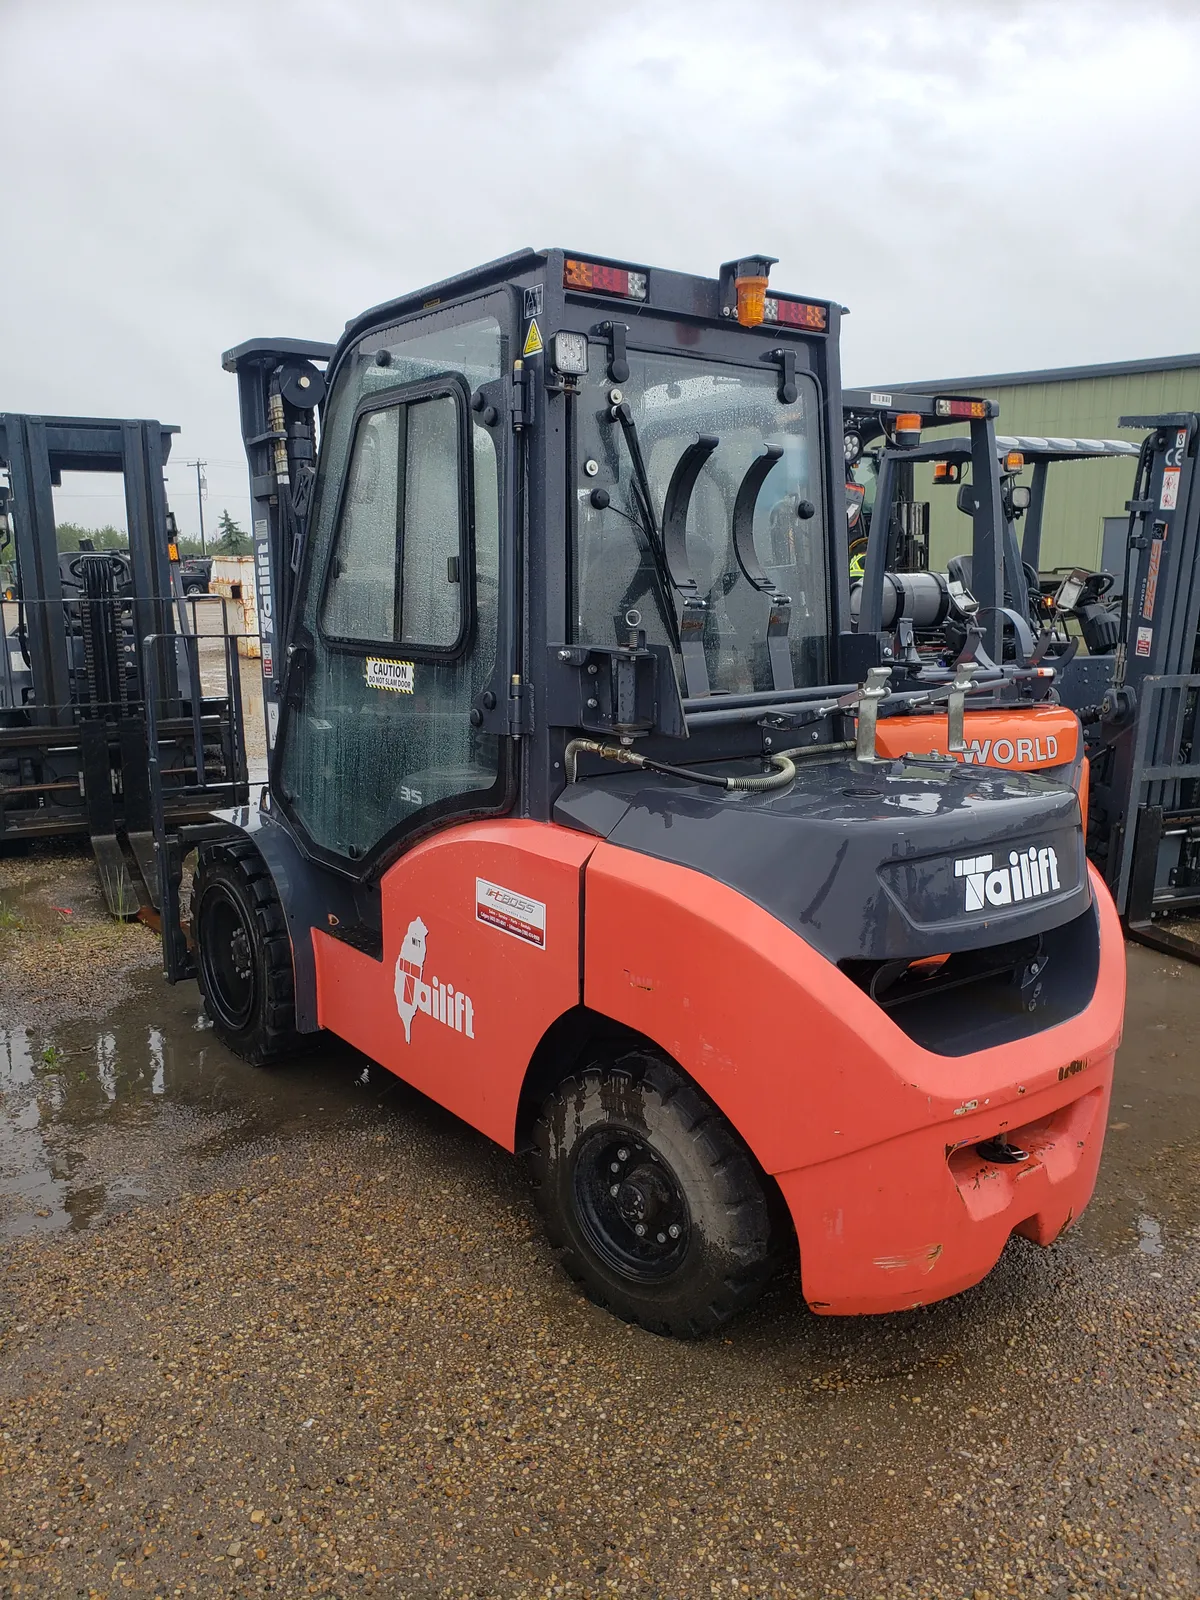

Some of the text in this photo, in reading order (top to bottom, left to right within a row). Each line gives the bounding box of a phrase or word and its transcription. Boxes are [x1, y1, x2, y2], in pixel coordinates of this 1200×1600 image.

[1165, 448, 1184, 466] CE
[257, 542, 273, 639] Tailift
[369, 675, 411, 688] DO NOT SLAM DOOR
[374, 663, 406, 678] CAUTION
[962, 735, 1058, 764] WORLD
[954, 846, 1061, 912] Tailift
